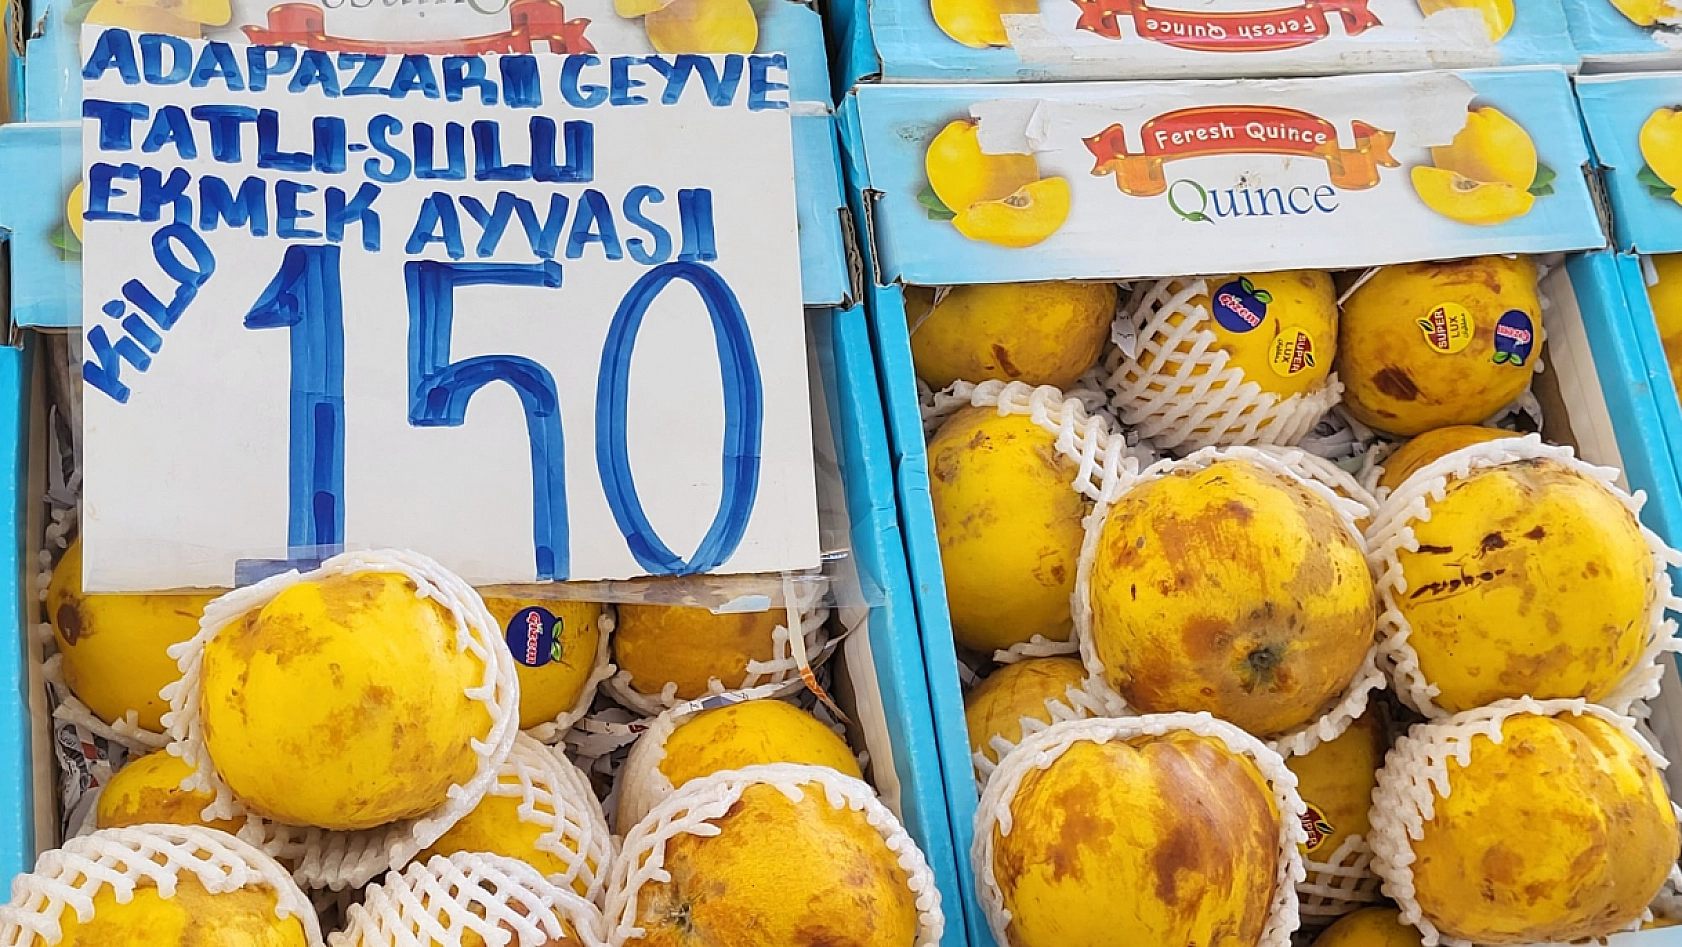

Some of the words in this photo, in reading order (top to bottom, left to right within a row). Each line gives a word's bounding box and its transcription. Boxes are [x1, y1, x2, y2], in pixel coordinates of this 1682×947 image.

[1145, 17, 1227, 40] Quince
[1238, 16, 1317, 39] Feresh
[82, 28, 543, 108] ADAPAZARI
[560, 53, 790, 111] GEYVE
[82, 99, 594, 182] TATLI-SULU
[1155, 122, 1234, 149] Feresh
[1245, 122, 1327, 145] Quince
[82, 163, 382, 253] EKMEK
[405, 184, 718, 265] AYVASI
[1168, 178, 1339, 225] Quince
[1435, 310, 1448, 349] SUPER
[1449, 315, 1460, 339] LUX
[1282, 342, 1294, 363] LUX
[1290, 333, 1306, 372] SUPER
[234, 243, 764, 582] 150
